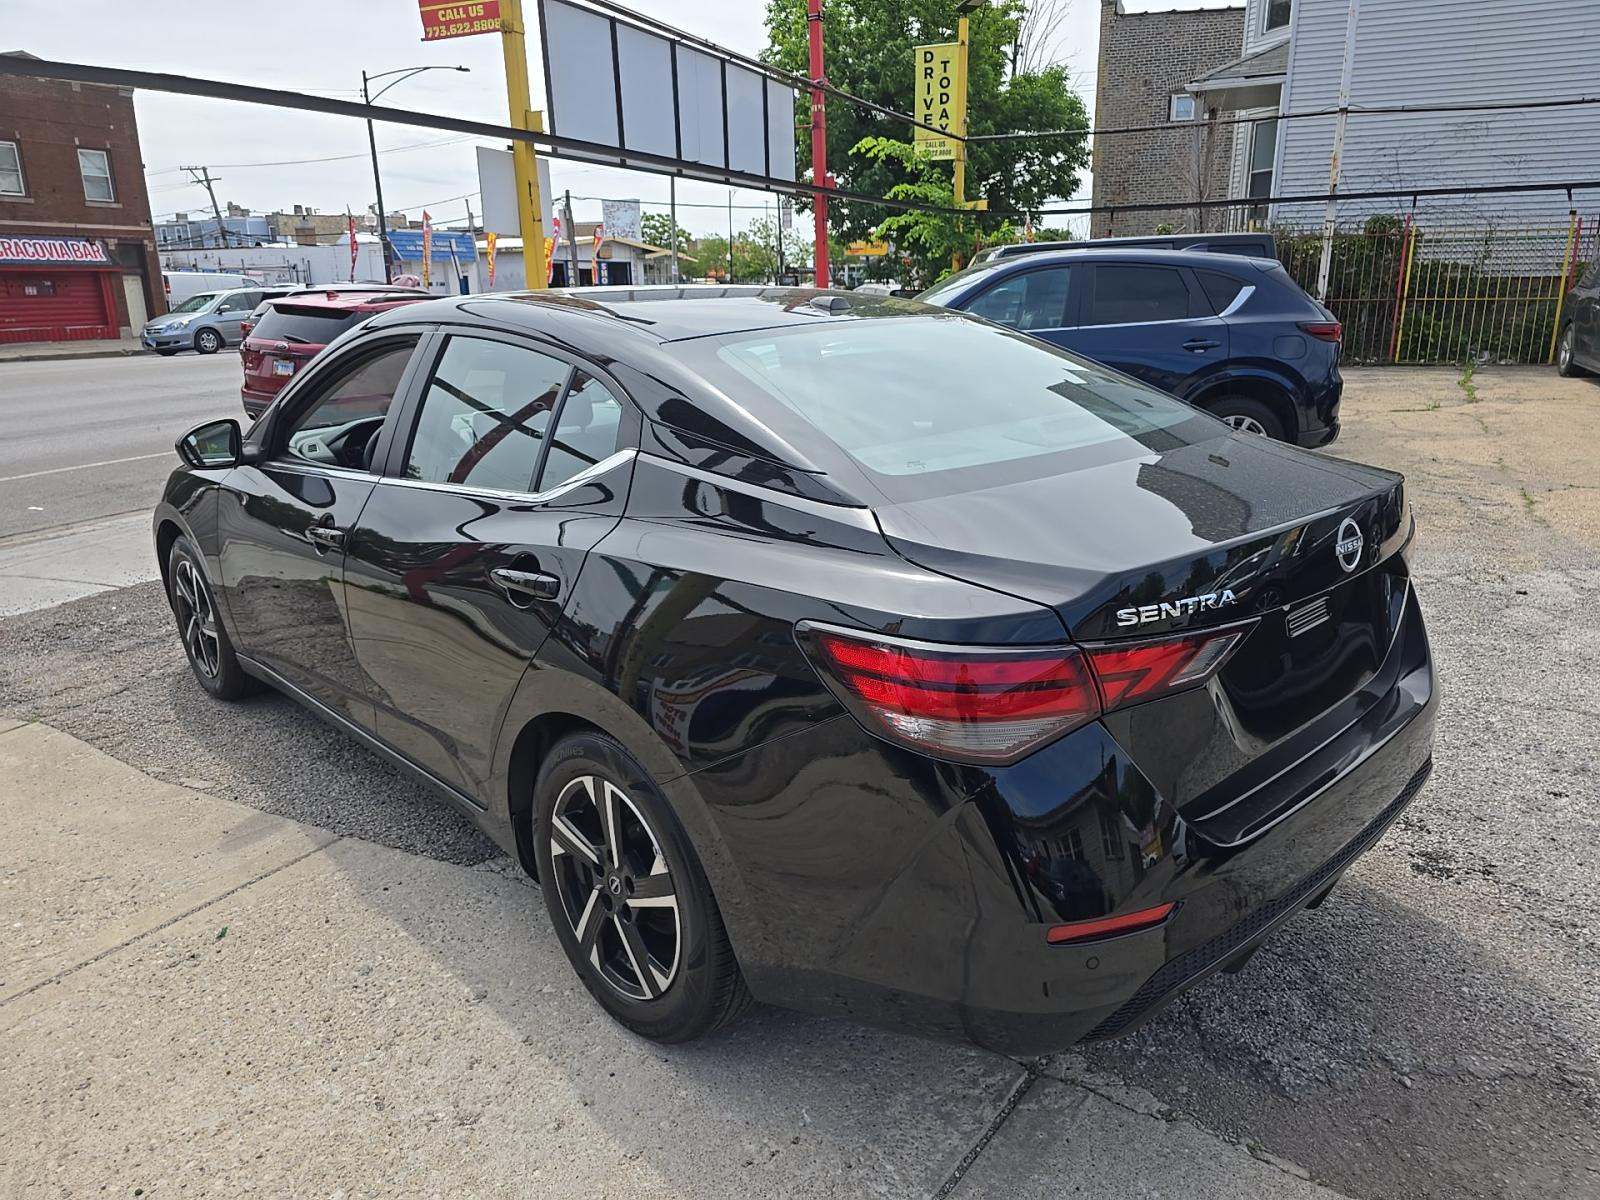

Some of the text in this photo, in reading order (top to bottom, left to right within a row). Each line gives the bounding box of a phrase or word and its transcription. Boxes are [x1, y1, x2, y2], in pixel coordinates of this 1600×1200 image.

[438, 5, 484, 21] CALL US
[425, 18, 500, 38] 773.622.8808
[923, 51, 934, 125] DRIVE
[939, 60, 951, 132] TODAY
[0, 239, 107, 261] RACOVIA BAR
[1117, 590, 1237, 626] SENTRA
